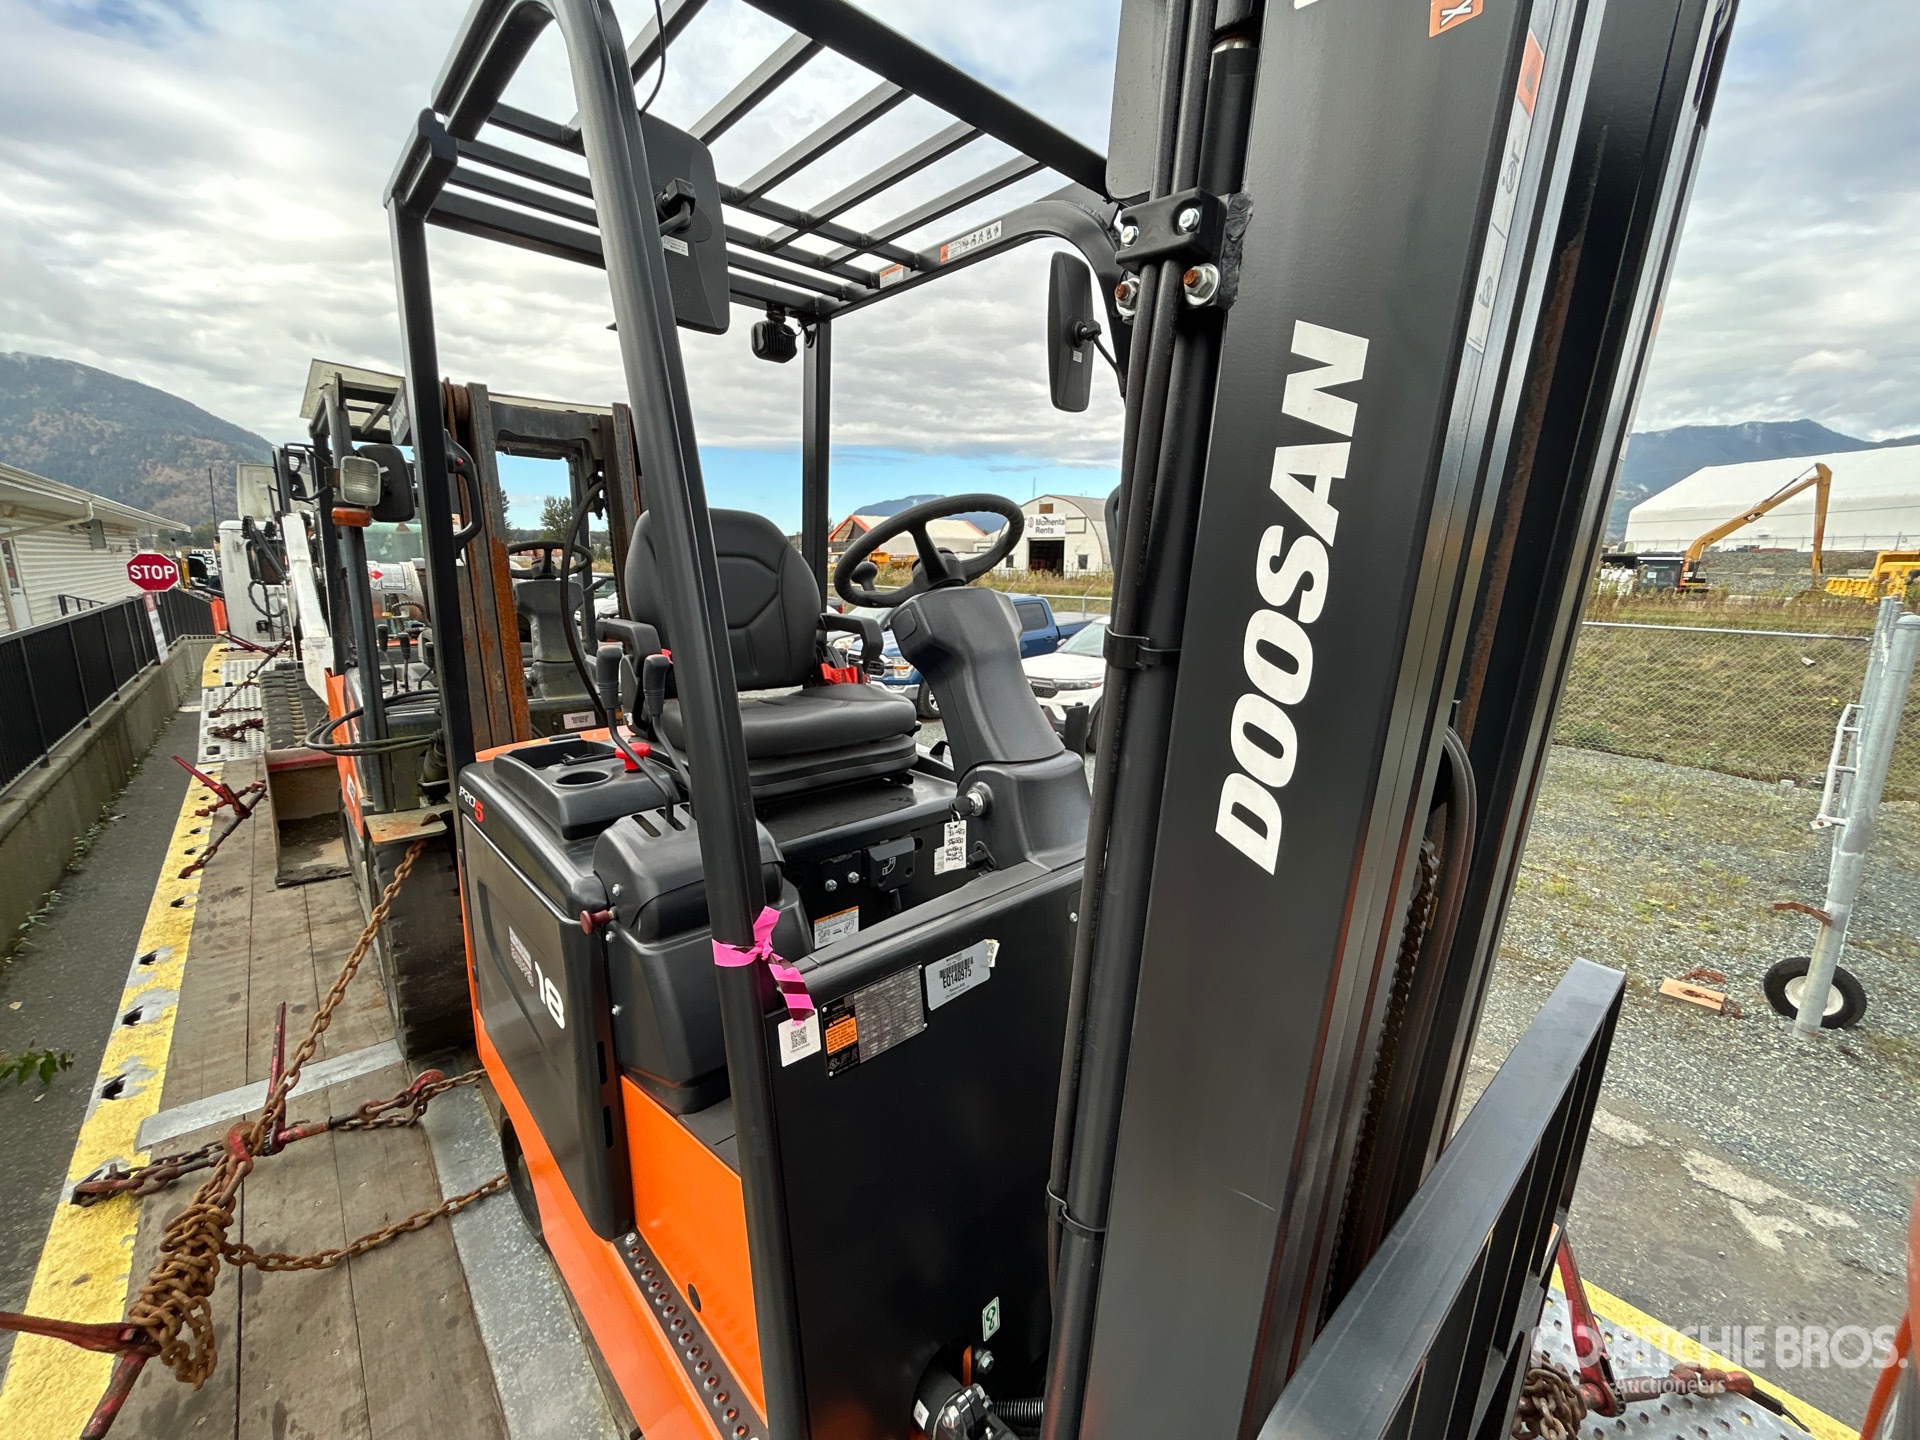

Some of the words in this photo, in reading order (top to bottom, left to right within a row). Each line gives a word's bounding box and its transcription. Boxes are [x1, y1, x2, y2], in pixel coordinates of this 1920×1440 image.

[130, 565, 174, 580] STOP
[1215, 320, 1369, 875] DOOSAN
[534, 961, 566, 1030] 18
[942, 965, 972, 988] EQ140975
